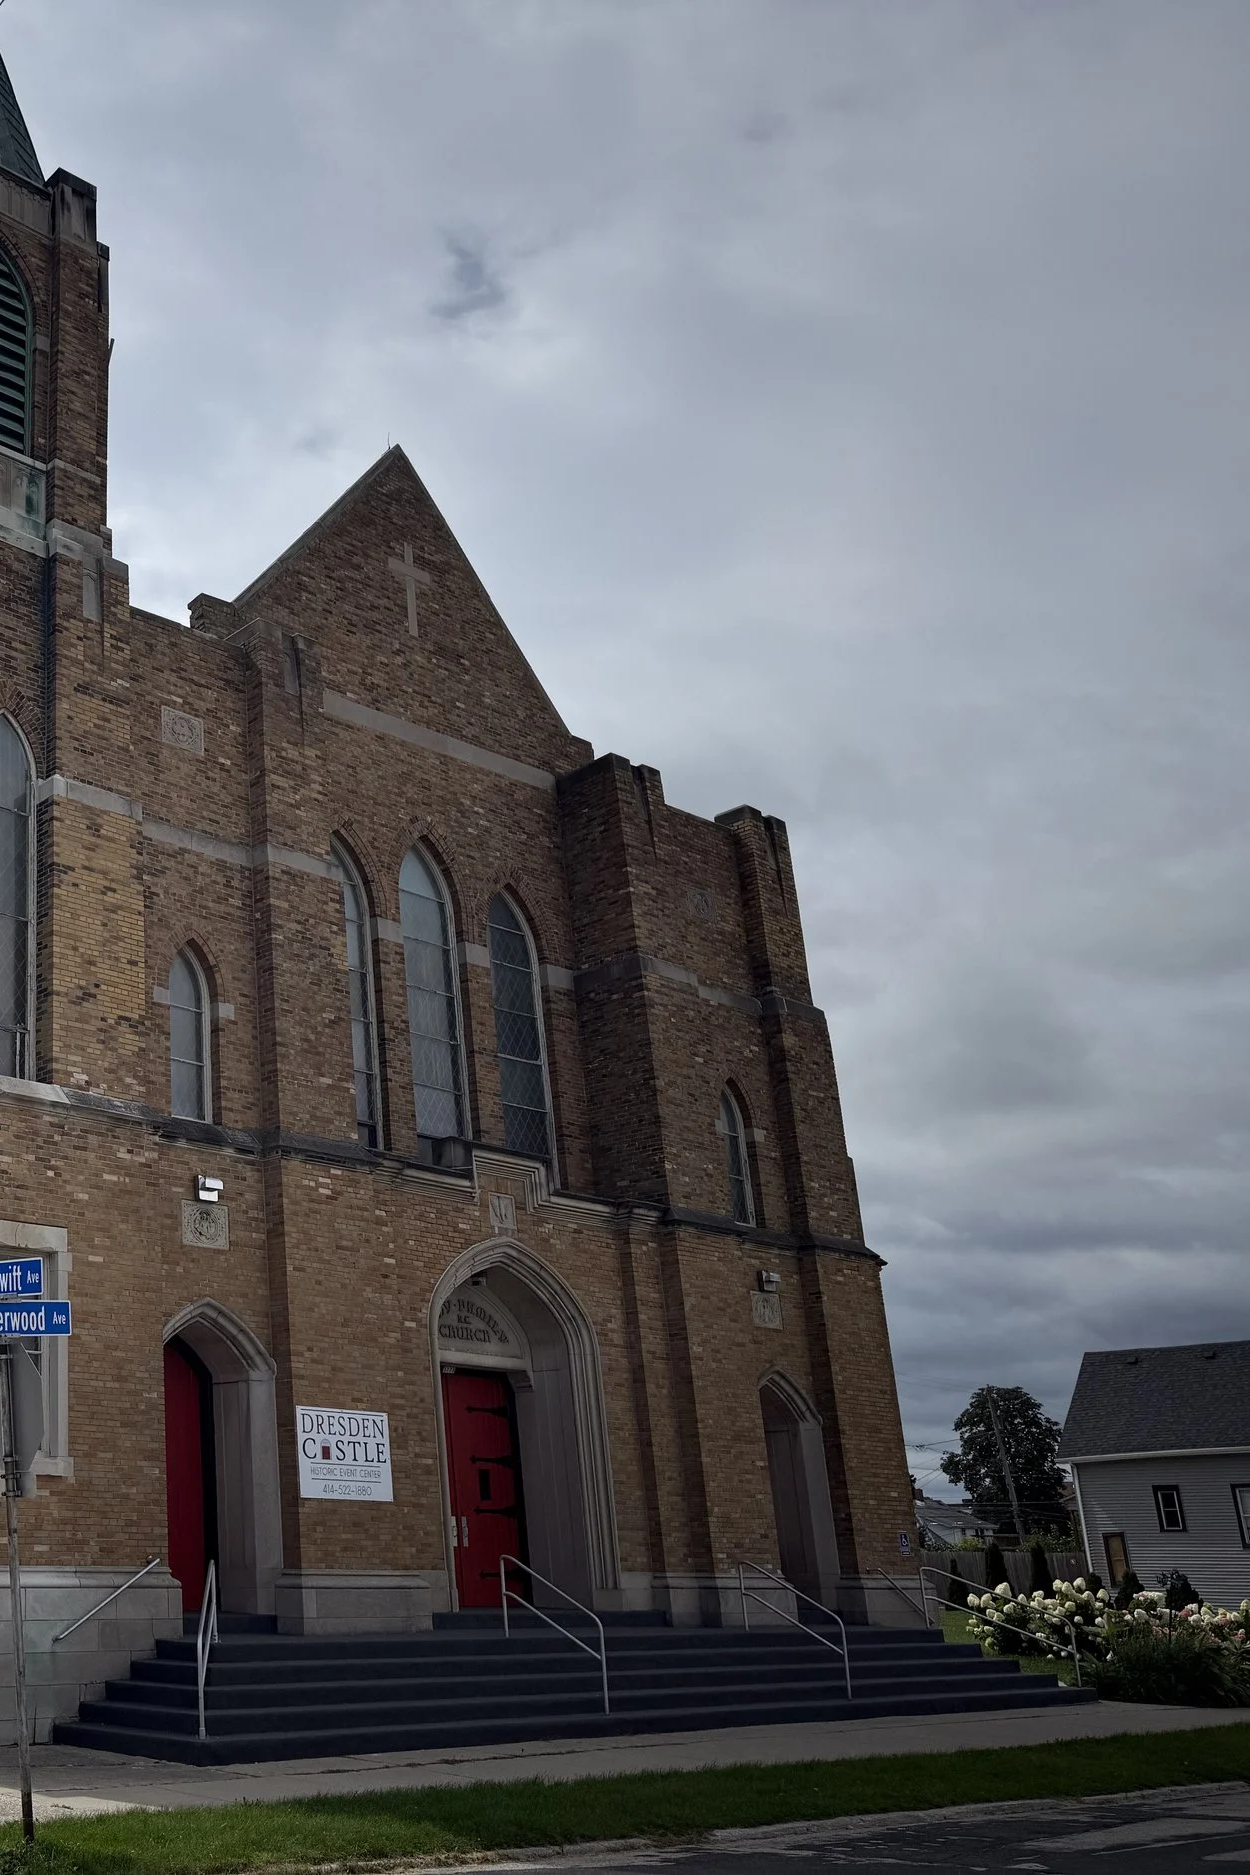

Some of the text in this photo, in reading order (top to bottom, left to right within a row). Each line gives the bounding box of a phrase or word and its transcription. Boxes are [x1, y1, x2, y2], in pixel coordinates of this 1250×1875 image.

[27, 1270, 39, 1284] Ave
[53, 1311, 67, 1325] Ave
[439, 1324, 491, 1343] CHURCH
[301, 1413, 384, 1439] DRESDEN
[302, 1437, 387, 1464] CSTLE
[310, 1467, 382, 1479] HISTORIC EVENT CENTER
[322, 1483, 372, 1496] 414-522-1880
